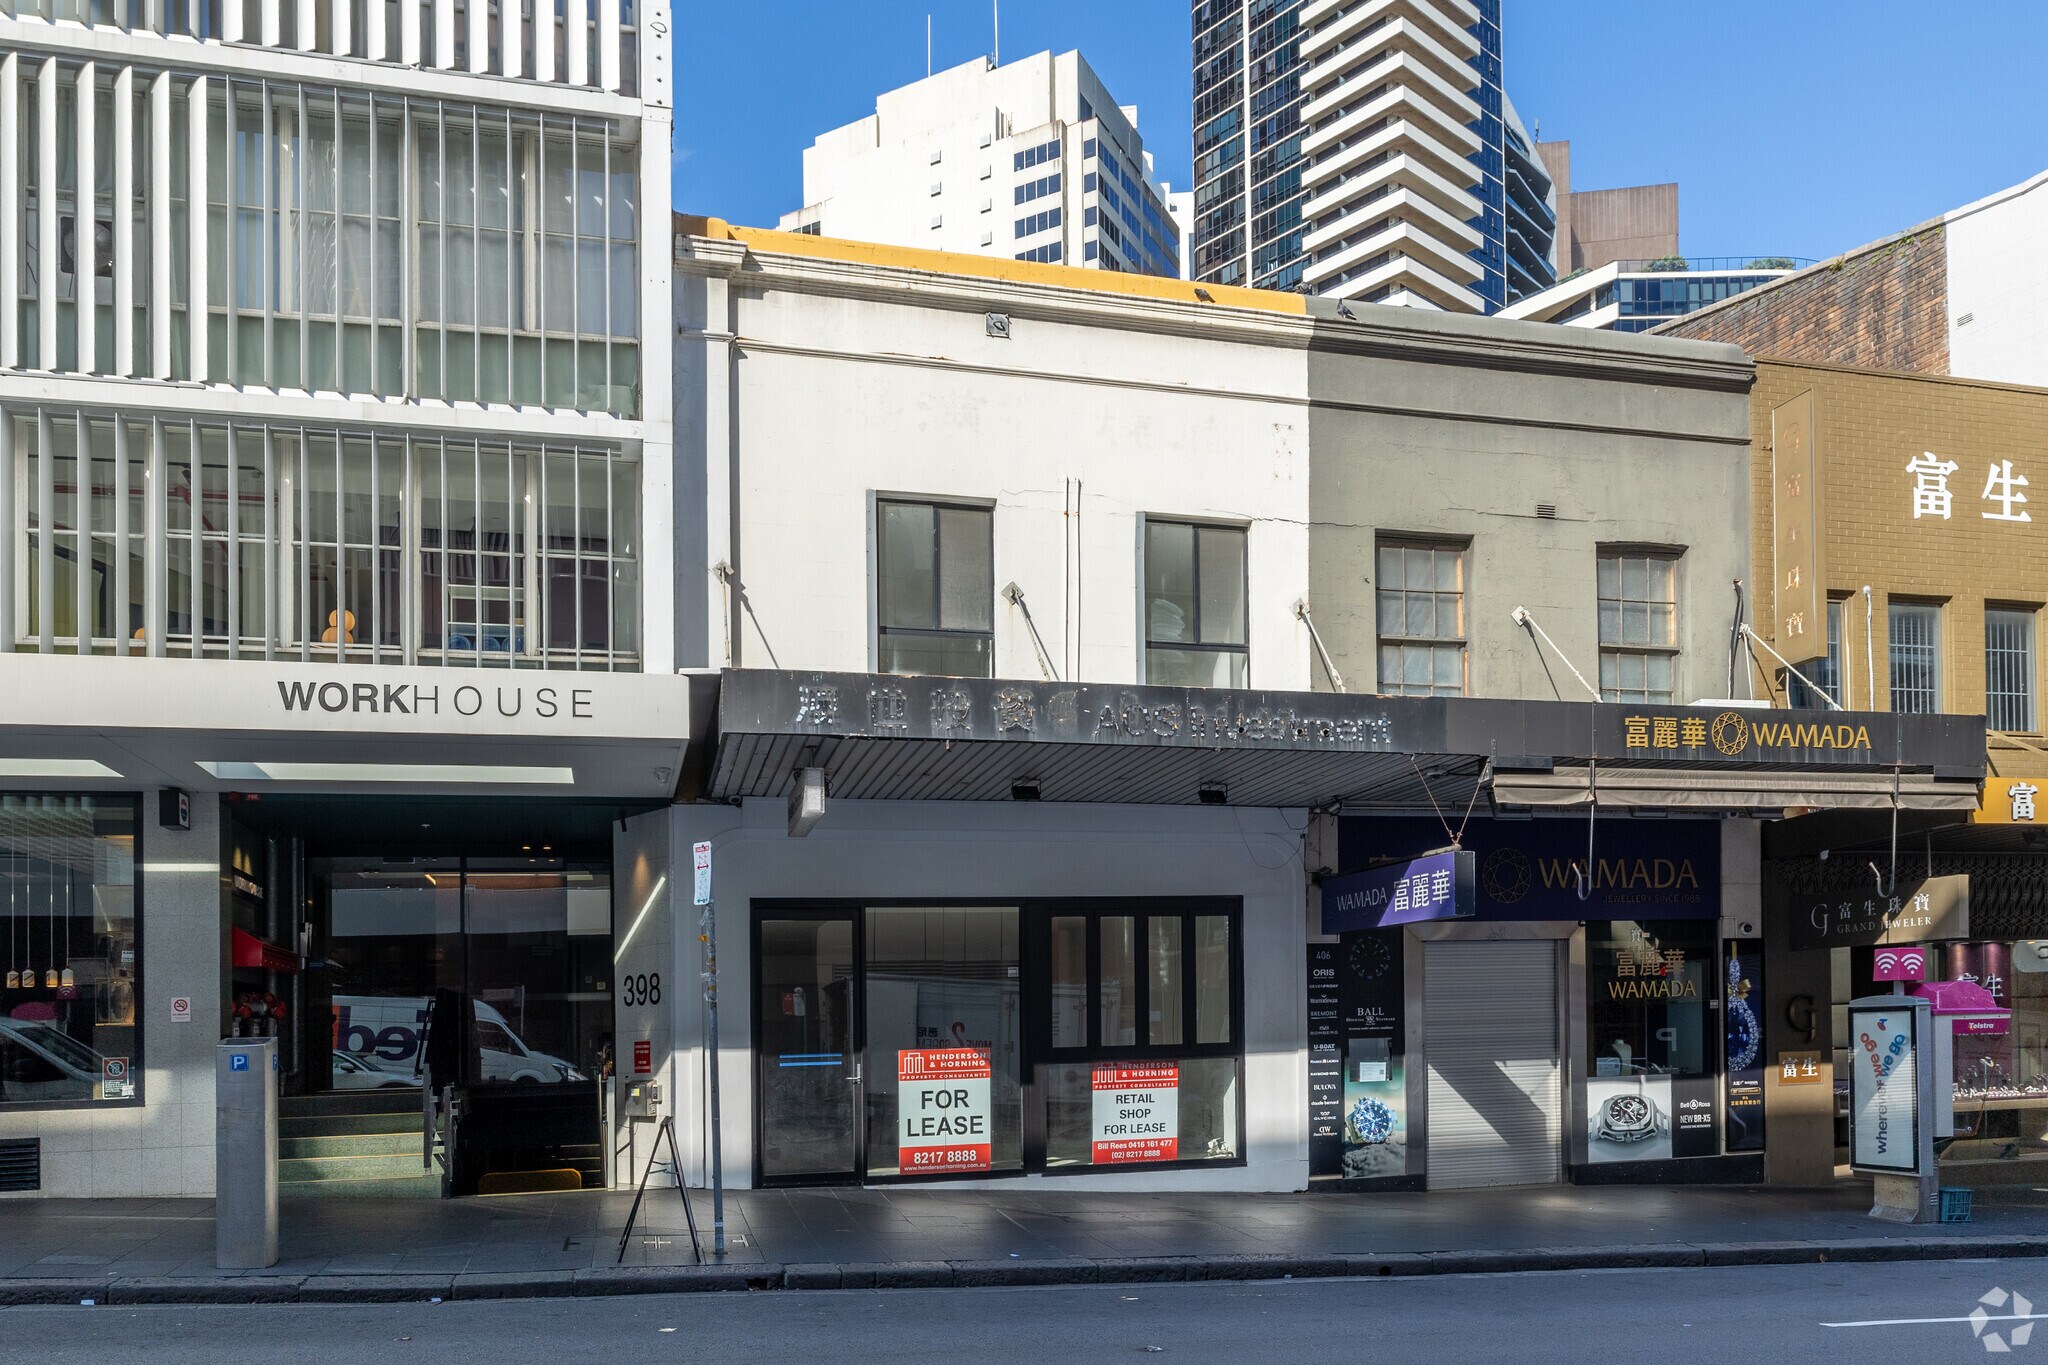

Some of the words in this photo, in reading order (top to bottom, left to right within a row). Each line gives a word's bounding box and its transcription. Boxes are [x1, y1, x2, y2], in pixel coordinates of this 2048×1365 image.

[1905, 451, 2032, 523] 富生
[278, 681, 593, 718] WORKHOUSE
[1624, 715, 1706, 750] 富麗華
[1752, 722, 1872, 750] WAMADA
[2008, 782, 2038, 822] 富
[1538, 858, 1699, 889] WAMADA
[1337, 890, 1388, 911] WAMADA
[1394, 869, 1450, 912] 富麗華
[1603, 894, 1652, 903] JEWELLERY
[1654, 894, 1679, 902] SINCE
[1681, 894, 1700, 902] 1985
[1838, 893, 1930, 920] 富生珠寶
[1811, 904, 1830, 937] G
[1837, 922, 1876, 934] GRAND
[1880, 916, 1932, 930] JEWELER
[1316, 951, 1331, 960] 406
[1616, 948, 1685, 977] 富麗華
[624, 972, 660, 1007] 398
[1608, 980, 1696, 999] WAMADA
[1860, 1032, 1878, 1052] go
[1888, 1034, 1906, 1055] go
[233, 1056, 245, 1069] P
[1782, 1057, 1818, 1078] 富生
[1871, 1053, 1882, 1078] we
[1880, 1054, 1894, 1077] we
[921, 1089, 969, 1109] FOR
[1116, 1094, 1155, 1104] RETAIL
[1119, 1109, 1151, 1119] SHOP
[1680, 1115, 1693, 1123] NEW
[907, 1115, 983, 1137] LEASE
[1104, 1125, 1127, 1135] FOR
[1130, 1123, 1166, 1133] LEASE
[914, 1152, 943, 1164] 8217
[947, 1150, 976, 1162] 8888
